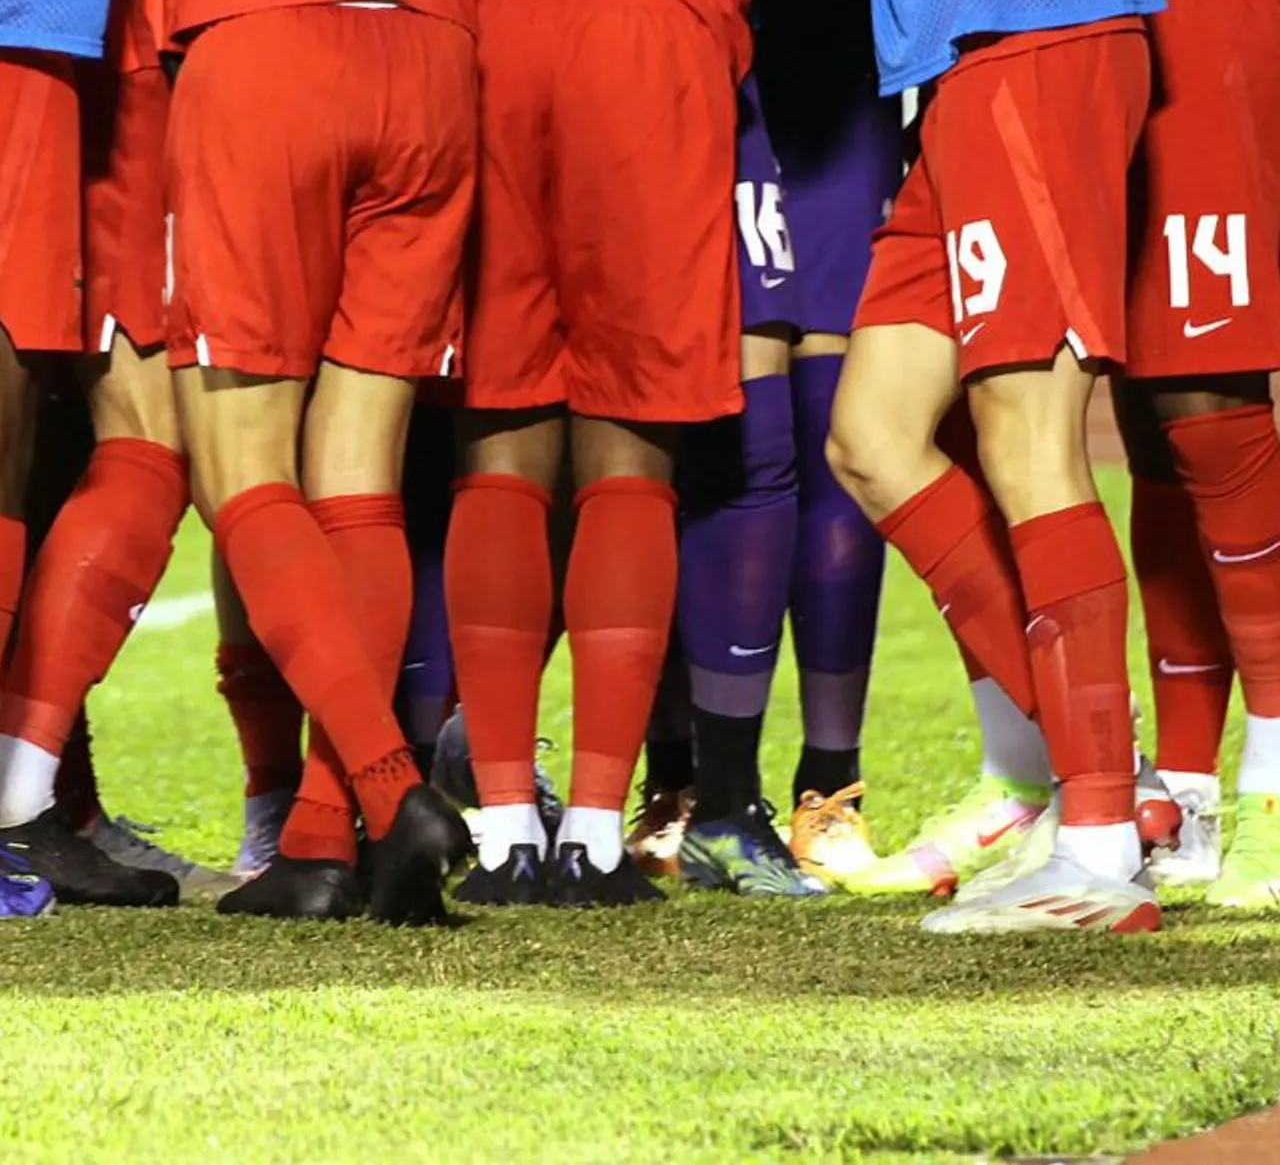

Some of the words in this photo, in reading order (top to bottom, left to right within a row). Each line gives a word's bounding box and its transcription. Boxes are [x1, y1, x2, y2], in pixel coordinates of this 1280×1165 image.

[735, 181, 796, 272] 16
[946, 219, 1008, 324] 19
[1163, 213, 1250, 308] 14
